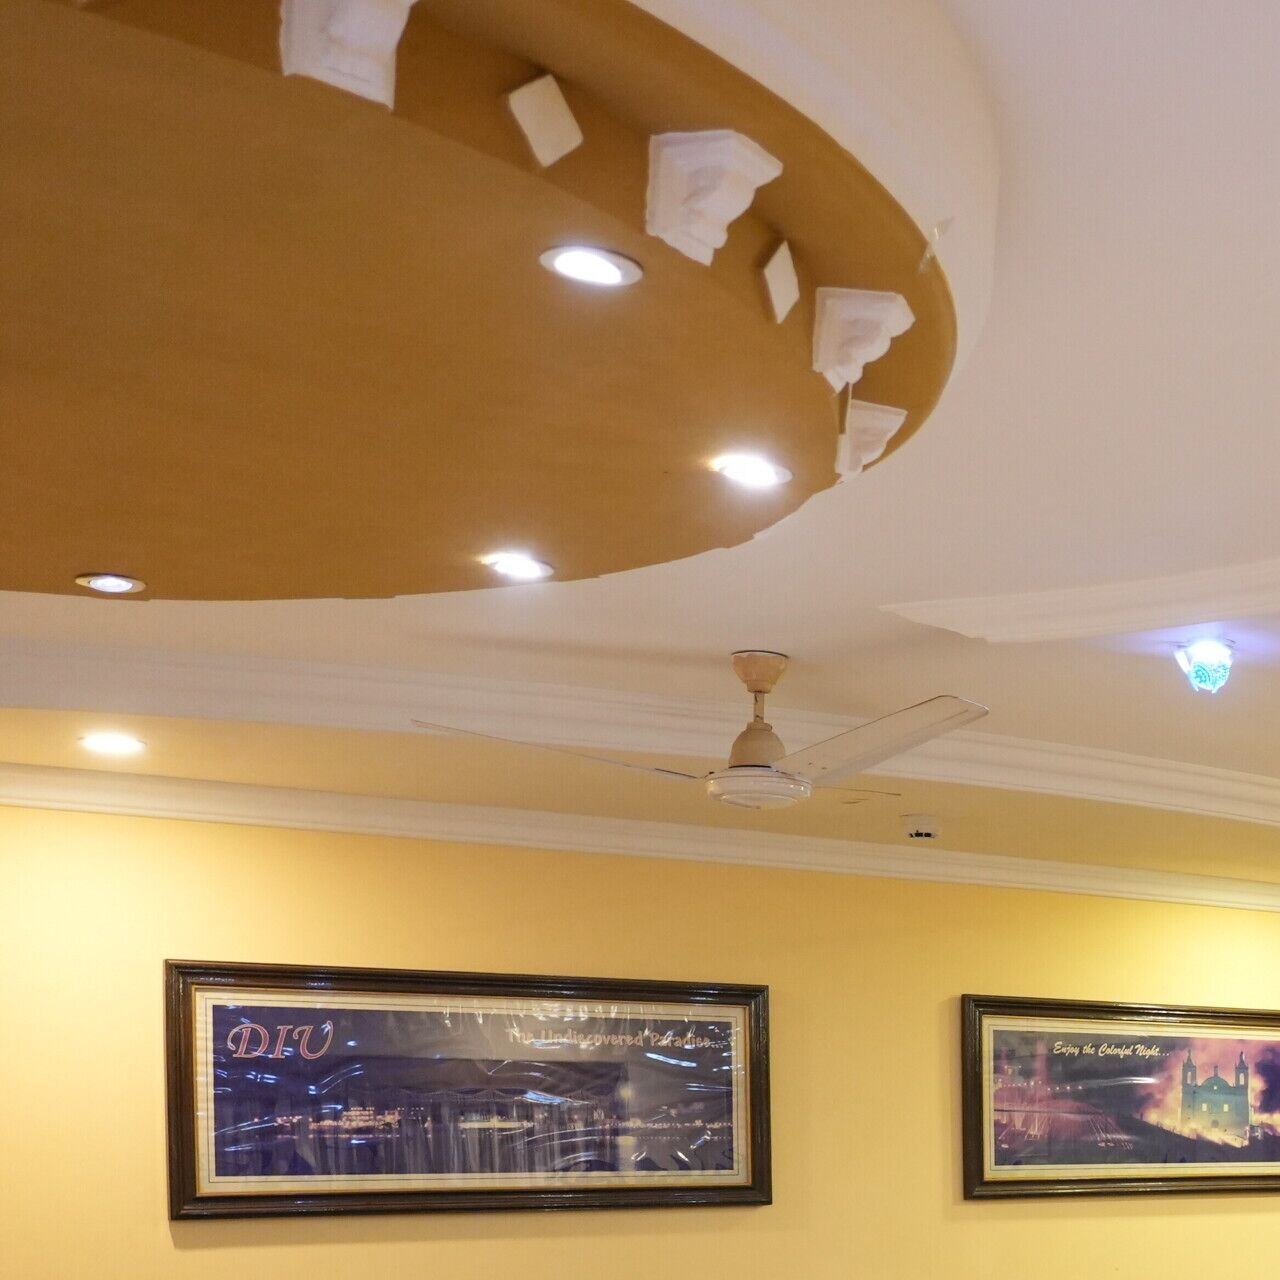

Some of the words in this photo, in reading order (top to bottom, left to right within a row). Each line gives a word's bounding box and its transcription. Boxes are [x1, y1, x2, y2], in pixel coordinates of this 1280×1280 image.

[227, 1020, 334, 1060] DIU
[507, 1028, 534, 1044] The
[540, 1028, 644, 1047] Undiscovered
[1053, 1041, 1080, 1056] Enjoy
[1083, 1043, 1096, 1055] the
[1098, 1043, 1134, 1058] Colorful
